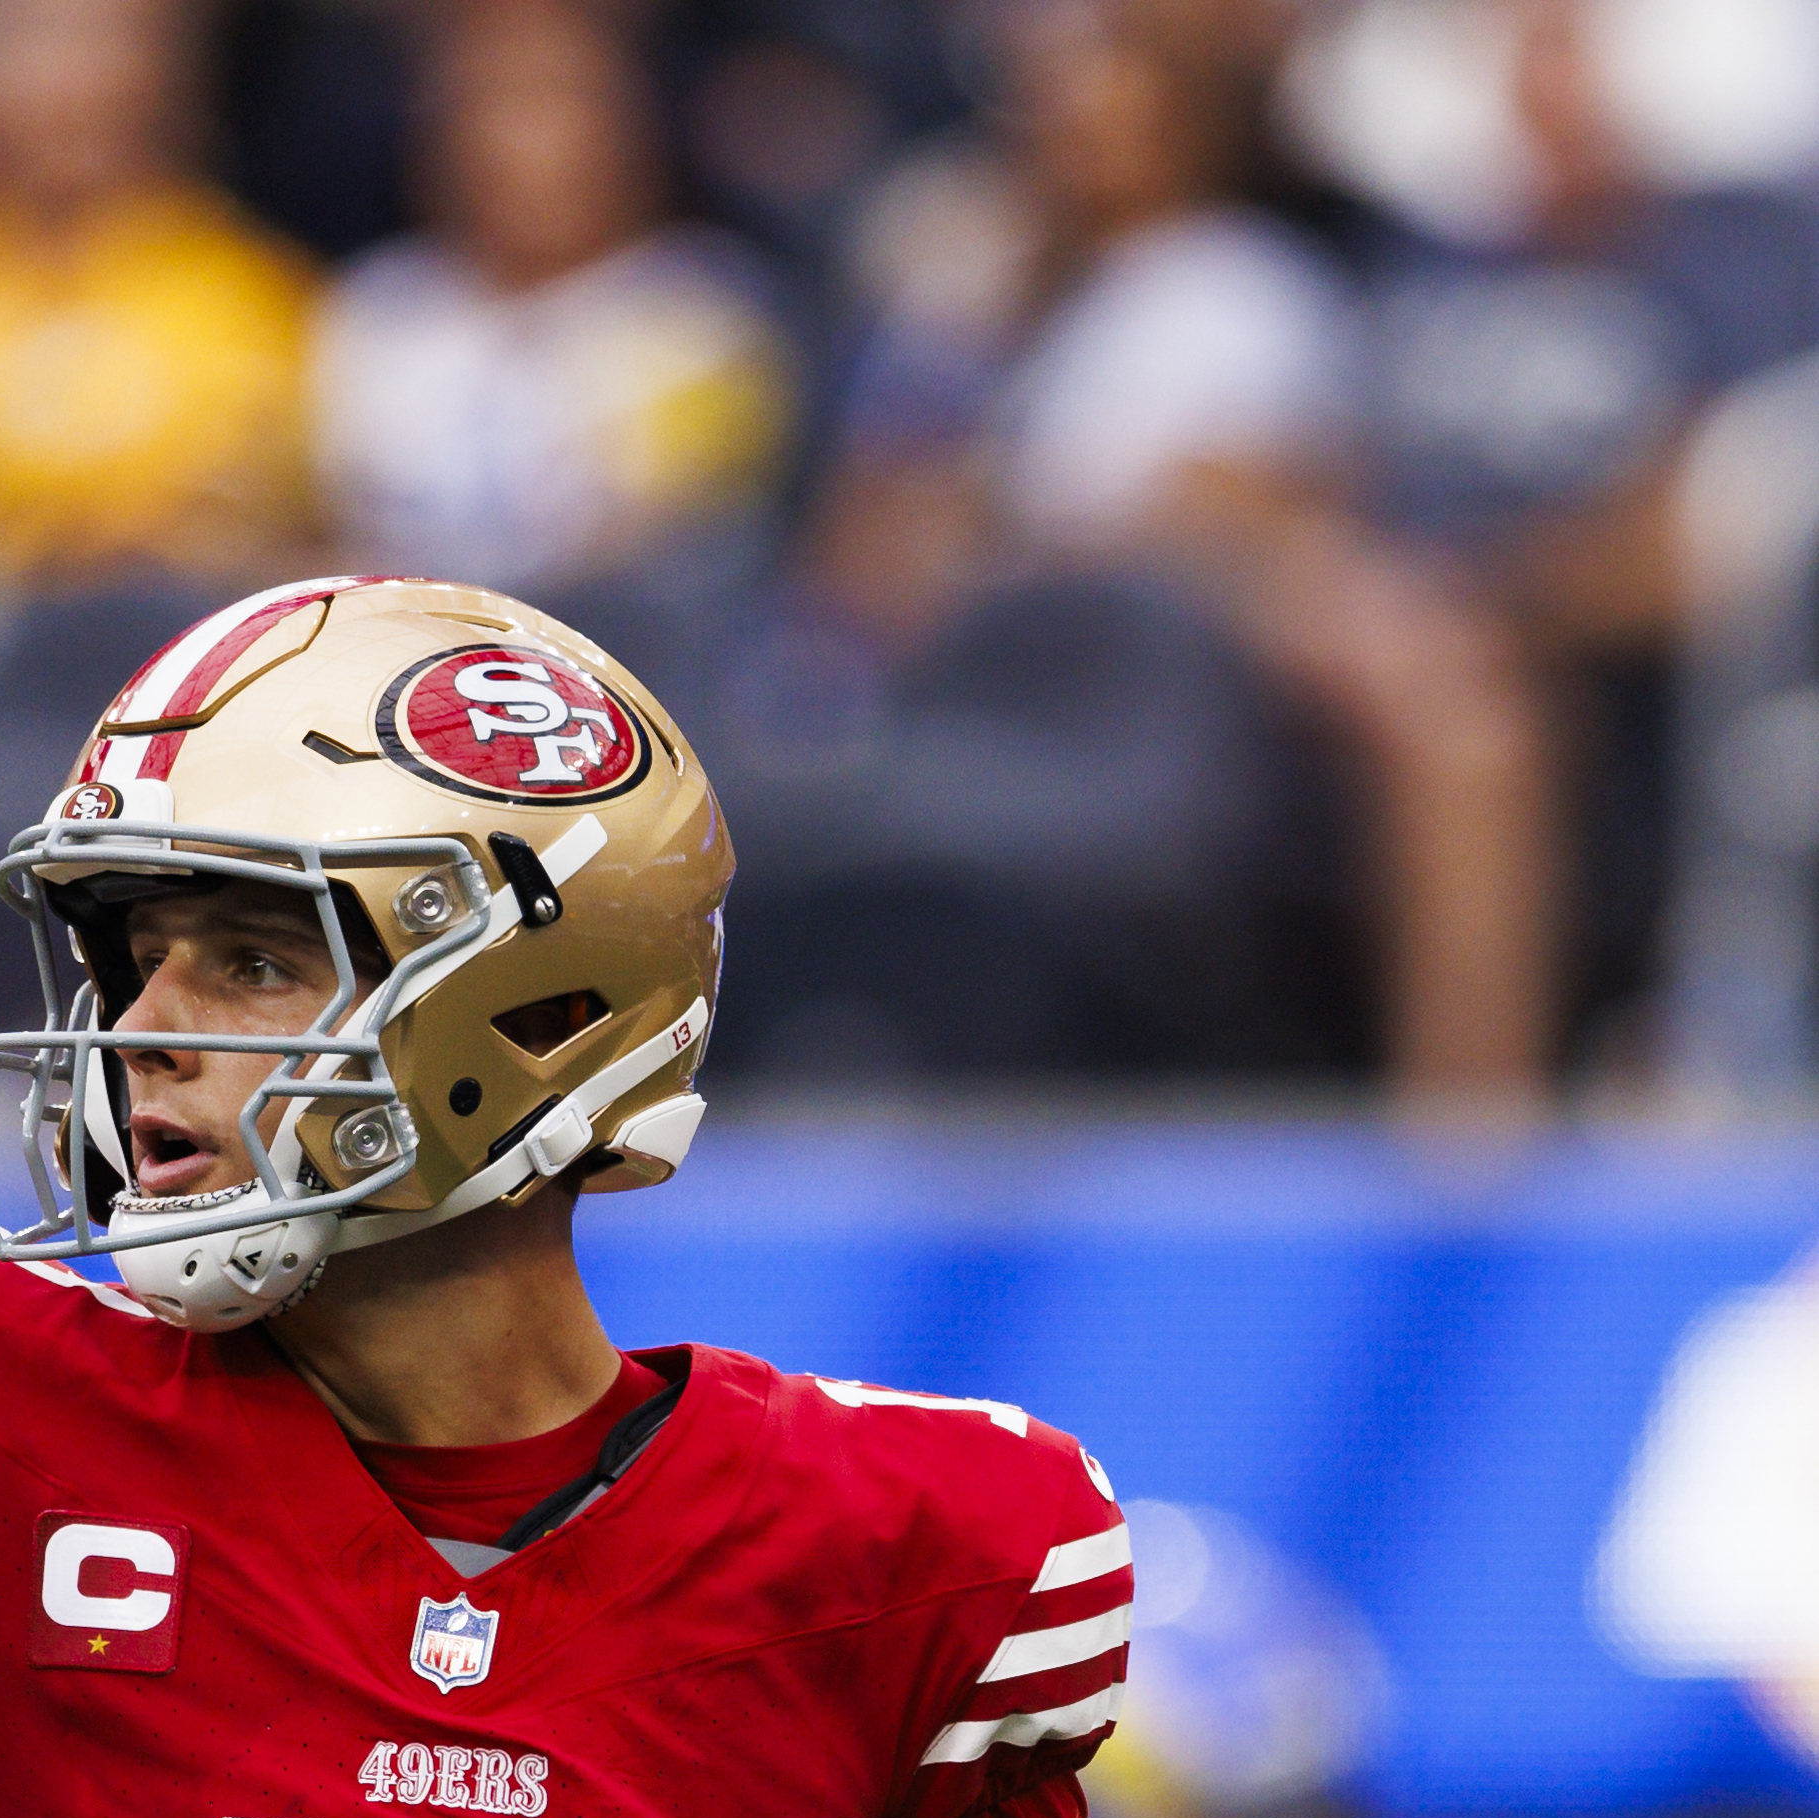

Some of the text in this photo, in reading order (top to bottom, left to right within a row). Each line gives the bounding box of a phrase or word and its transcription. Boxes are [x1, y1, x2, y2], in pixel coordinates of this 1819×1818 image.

[453, 660, 620, 786] SF
[672, 1021, 692, 1051] 13
[42, 1523, 175, 1632] C
[423, 1633, 478, 1675] NFL
[357, 1740, 549, 1818] 49ERS
